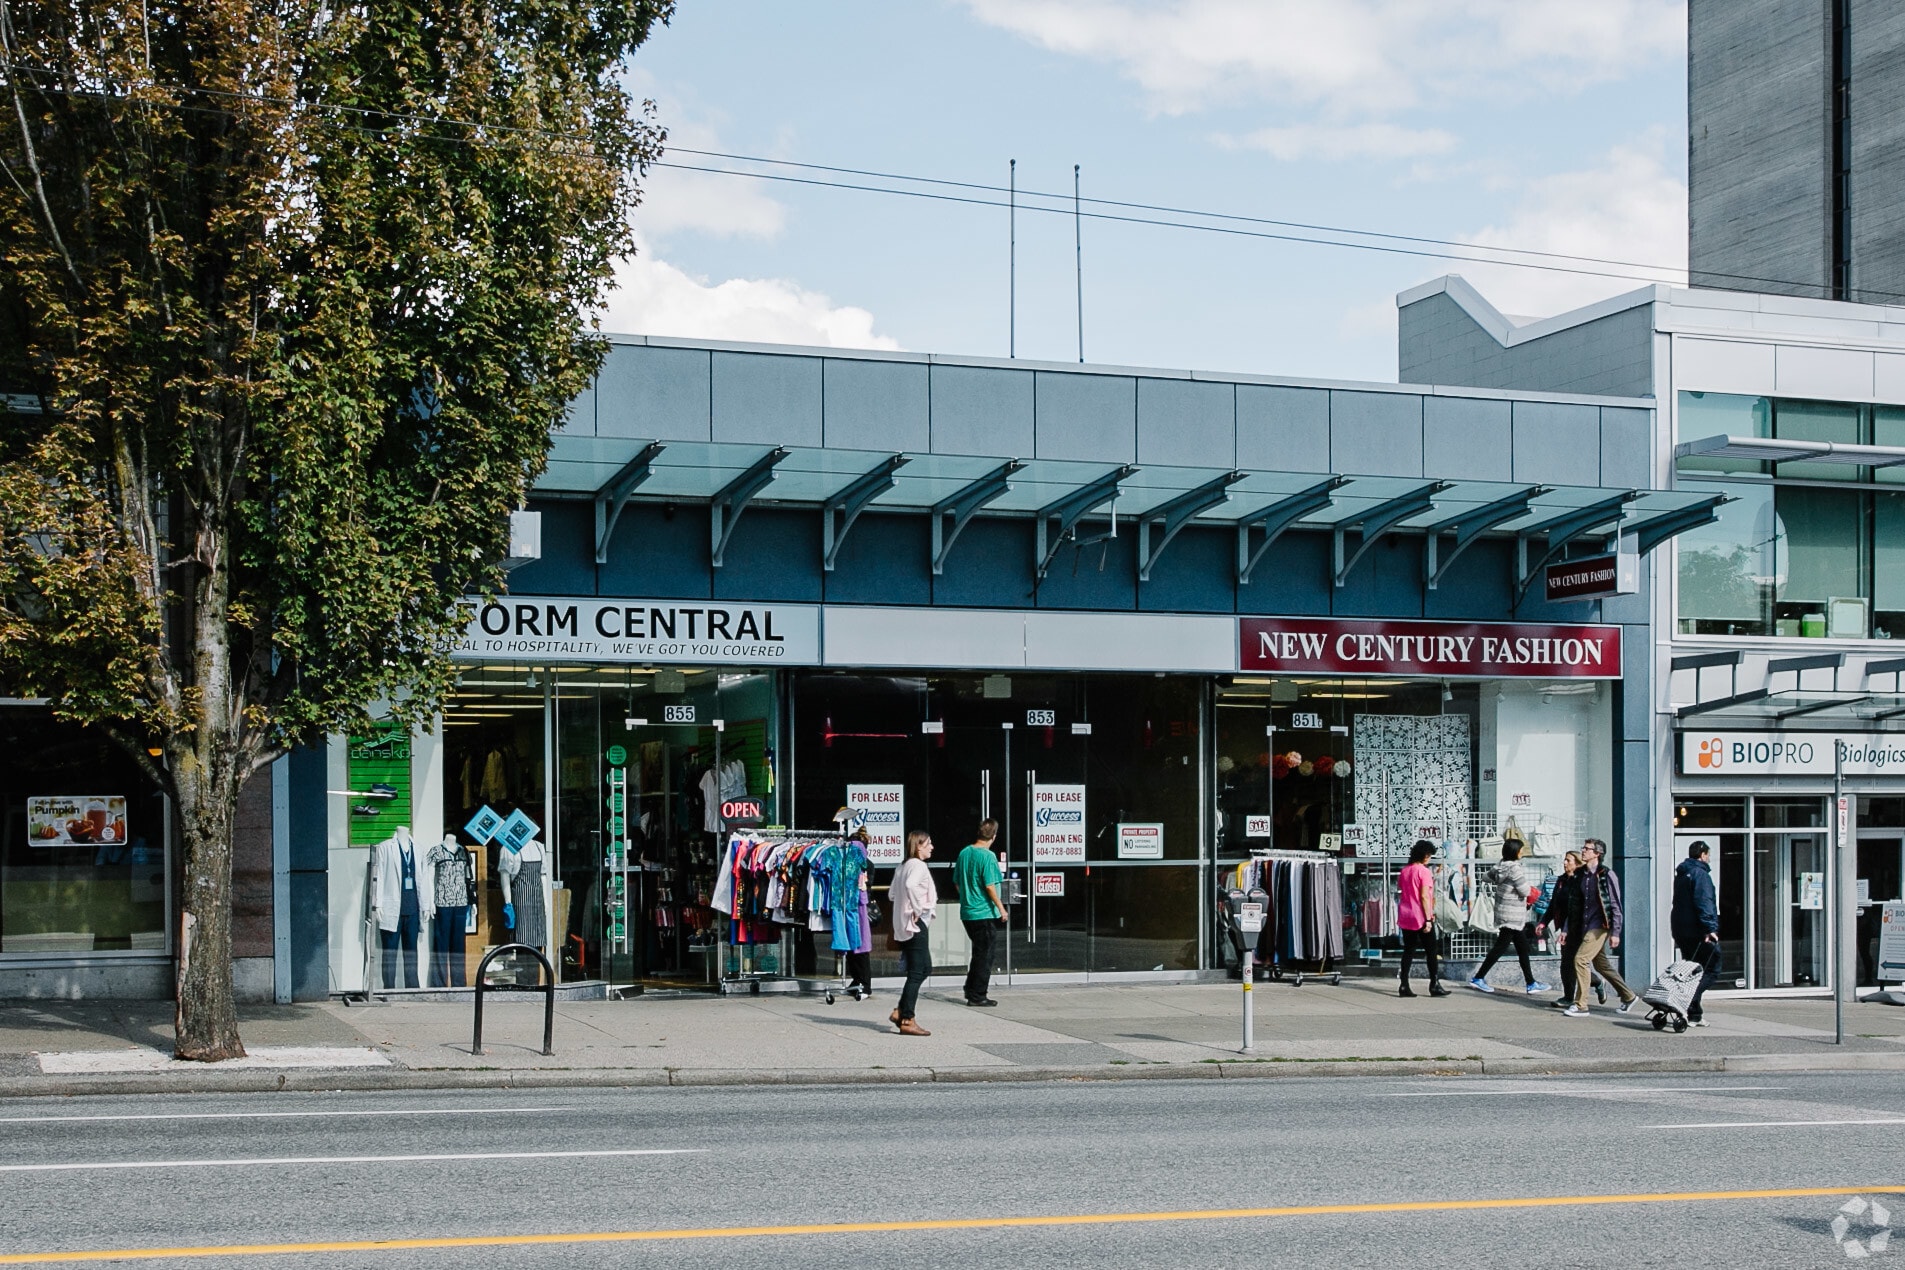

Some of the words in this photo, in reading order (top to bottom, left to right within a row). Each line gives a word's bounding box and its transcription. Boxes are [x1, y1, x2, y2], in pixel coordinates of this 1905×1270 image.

[1549, 577, 1561, 589] NEW
[1562, 572, 1589, 587] CENTURY
[1590, 568, 1616, 582] FASHION
[595, 606, 785, 642] CENTRAL
[485, 640, 503, 652] TO
[507, 640, 605, 655] HOSPITALITY,
[613, 643, 654, 655] WE'VE
[658, 643, 687, 655] GOT
[692, 644, 719, 656] YOU
[723, 645, 785, 657] COVERED
[1258, 631, 1328, 660] NEW
[1335, 633, 1475, 663] CENTURY
[1481, 637, 1603, 665] FASHION
[666, 706, 694, 720] 855
[1028, 711, 1054, 724] 853
[1732, 742, 1814, 764] BIOPRO
[851, 793, 870, 802] FOR
[873, 793, 900, 802] LEASE
[1036, 793, 1053, 802] FOR
[1056, 793, 1082, 802] LEASE
[1512, 793, 1531, 806] SALE
[35, 805, 80, 817] Pumpkin
[722, 802, 760, 818] OPEN
[1248, 820, 1269, 832] SALE
[1419, 825, 1441, 839] SALE
[868, 835, 883, 845] DAN
[885, 835, 902, 845] ENG
[1036, 834, 1066, 844] JORDAN
[1068, 834, 1083, 844] ENG
[1344, 828, 1365, 840] SALE
[1124, 839, 1134, 849] NO
[868, 848, 901, 857] 728-0883
[1036, 847, 1082, 856] 604-728-0883
[1038, 882, 1061, 893] CLOSED
